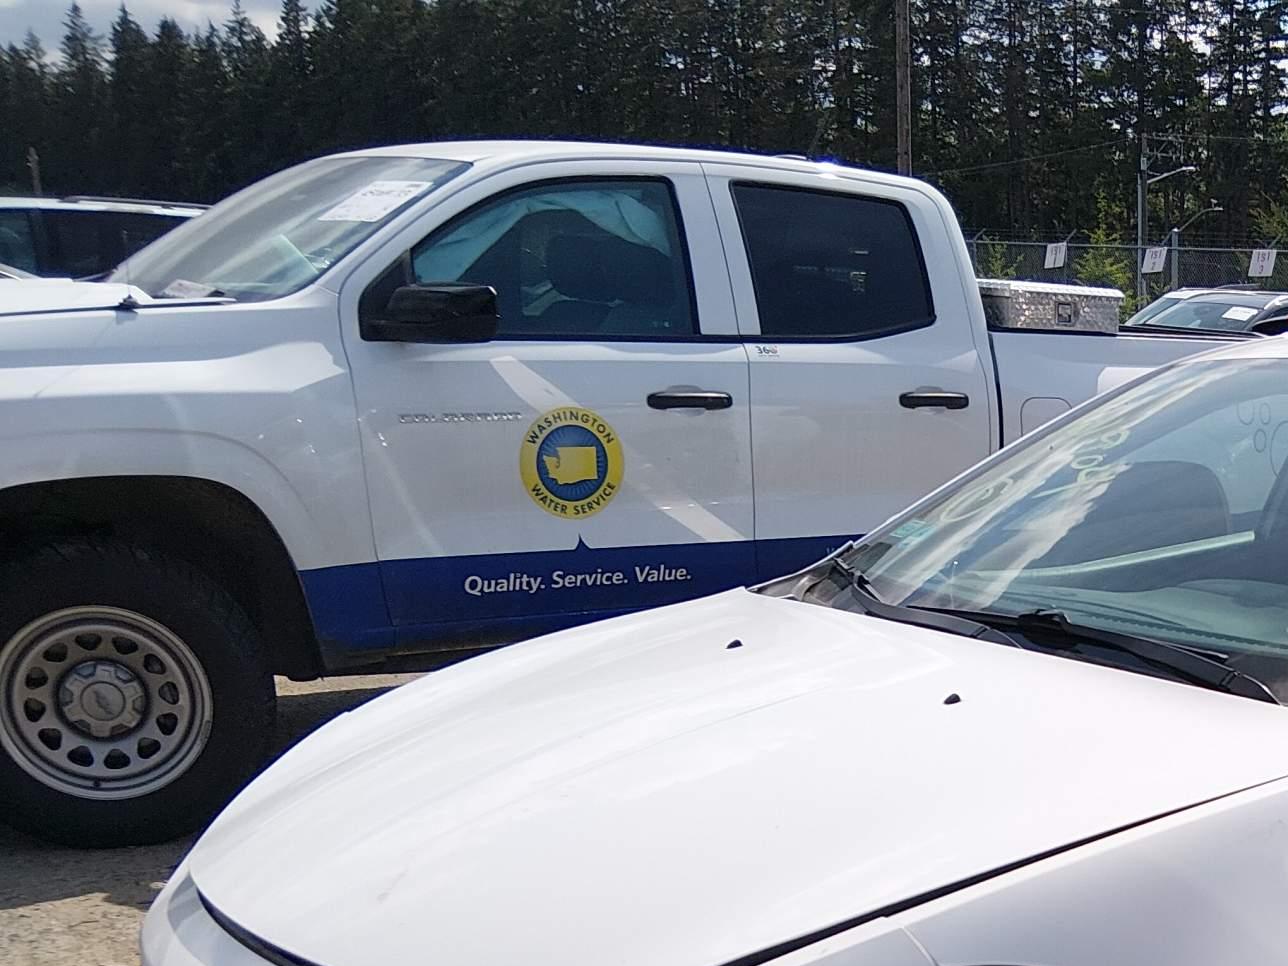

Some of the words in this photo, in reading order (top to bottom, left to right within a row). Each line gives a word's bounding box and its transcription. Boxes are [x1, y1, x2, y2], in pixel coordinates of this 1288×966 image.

[526, 410, 616, 446] WASHINGTON
[531, 483, 568, 514] WATER
[572, 481, 617, 515] SERVICE
[463, 573, 546, 596] Quality.
[551, 568, 629, 589] Service.
[634, 564, 692, 583] Value.
